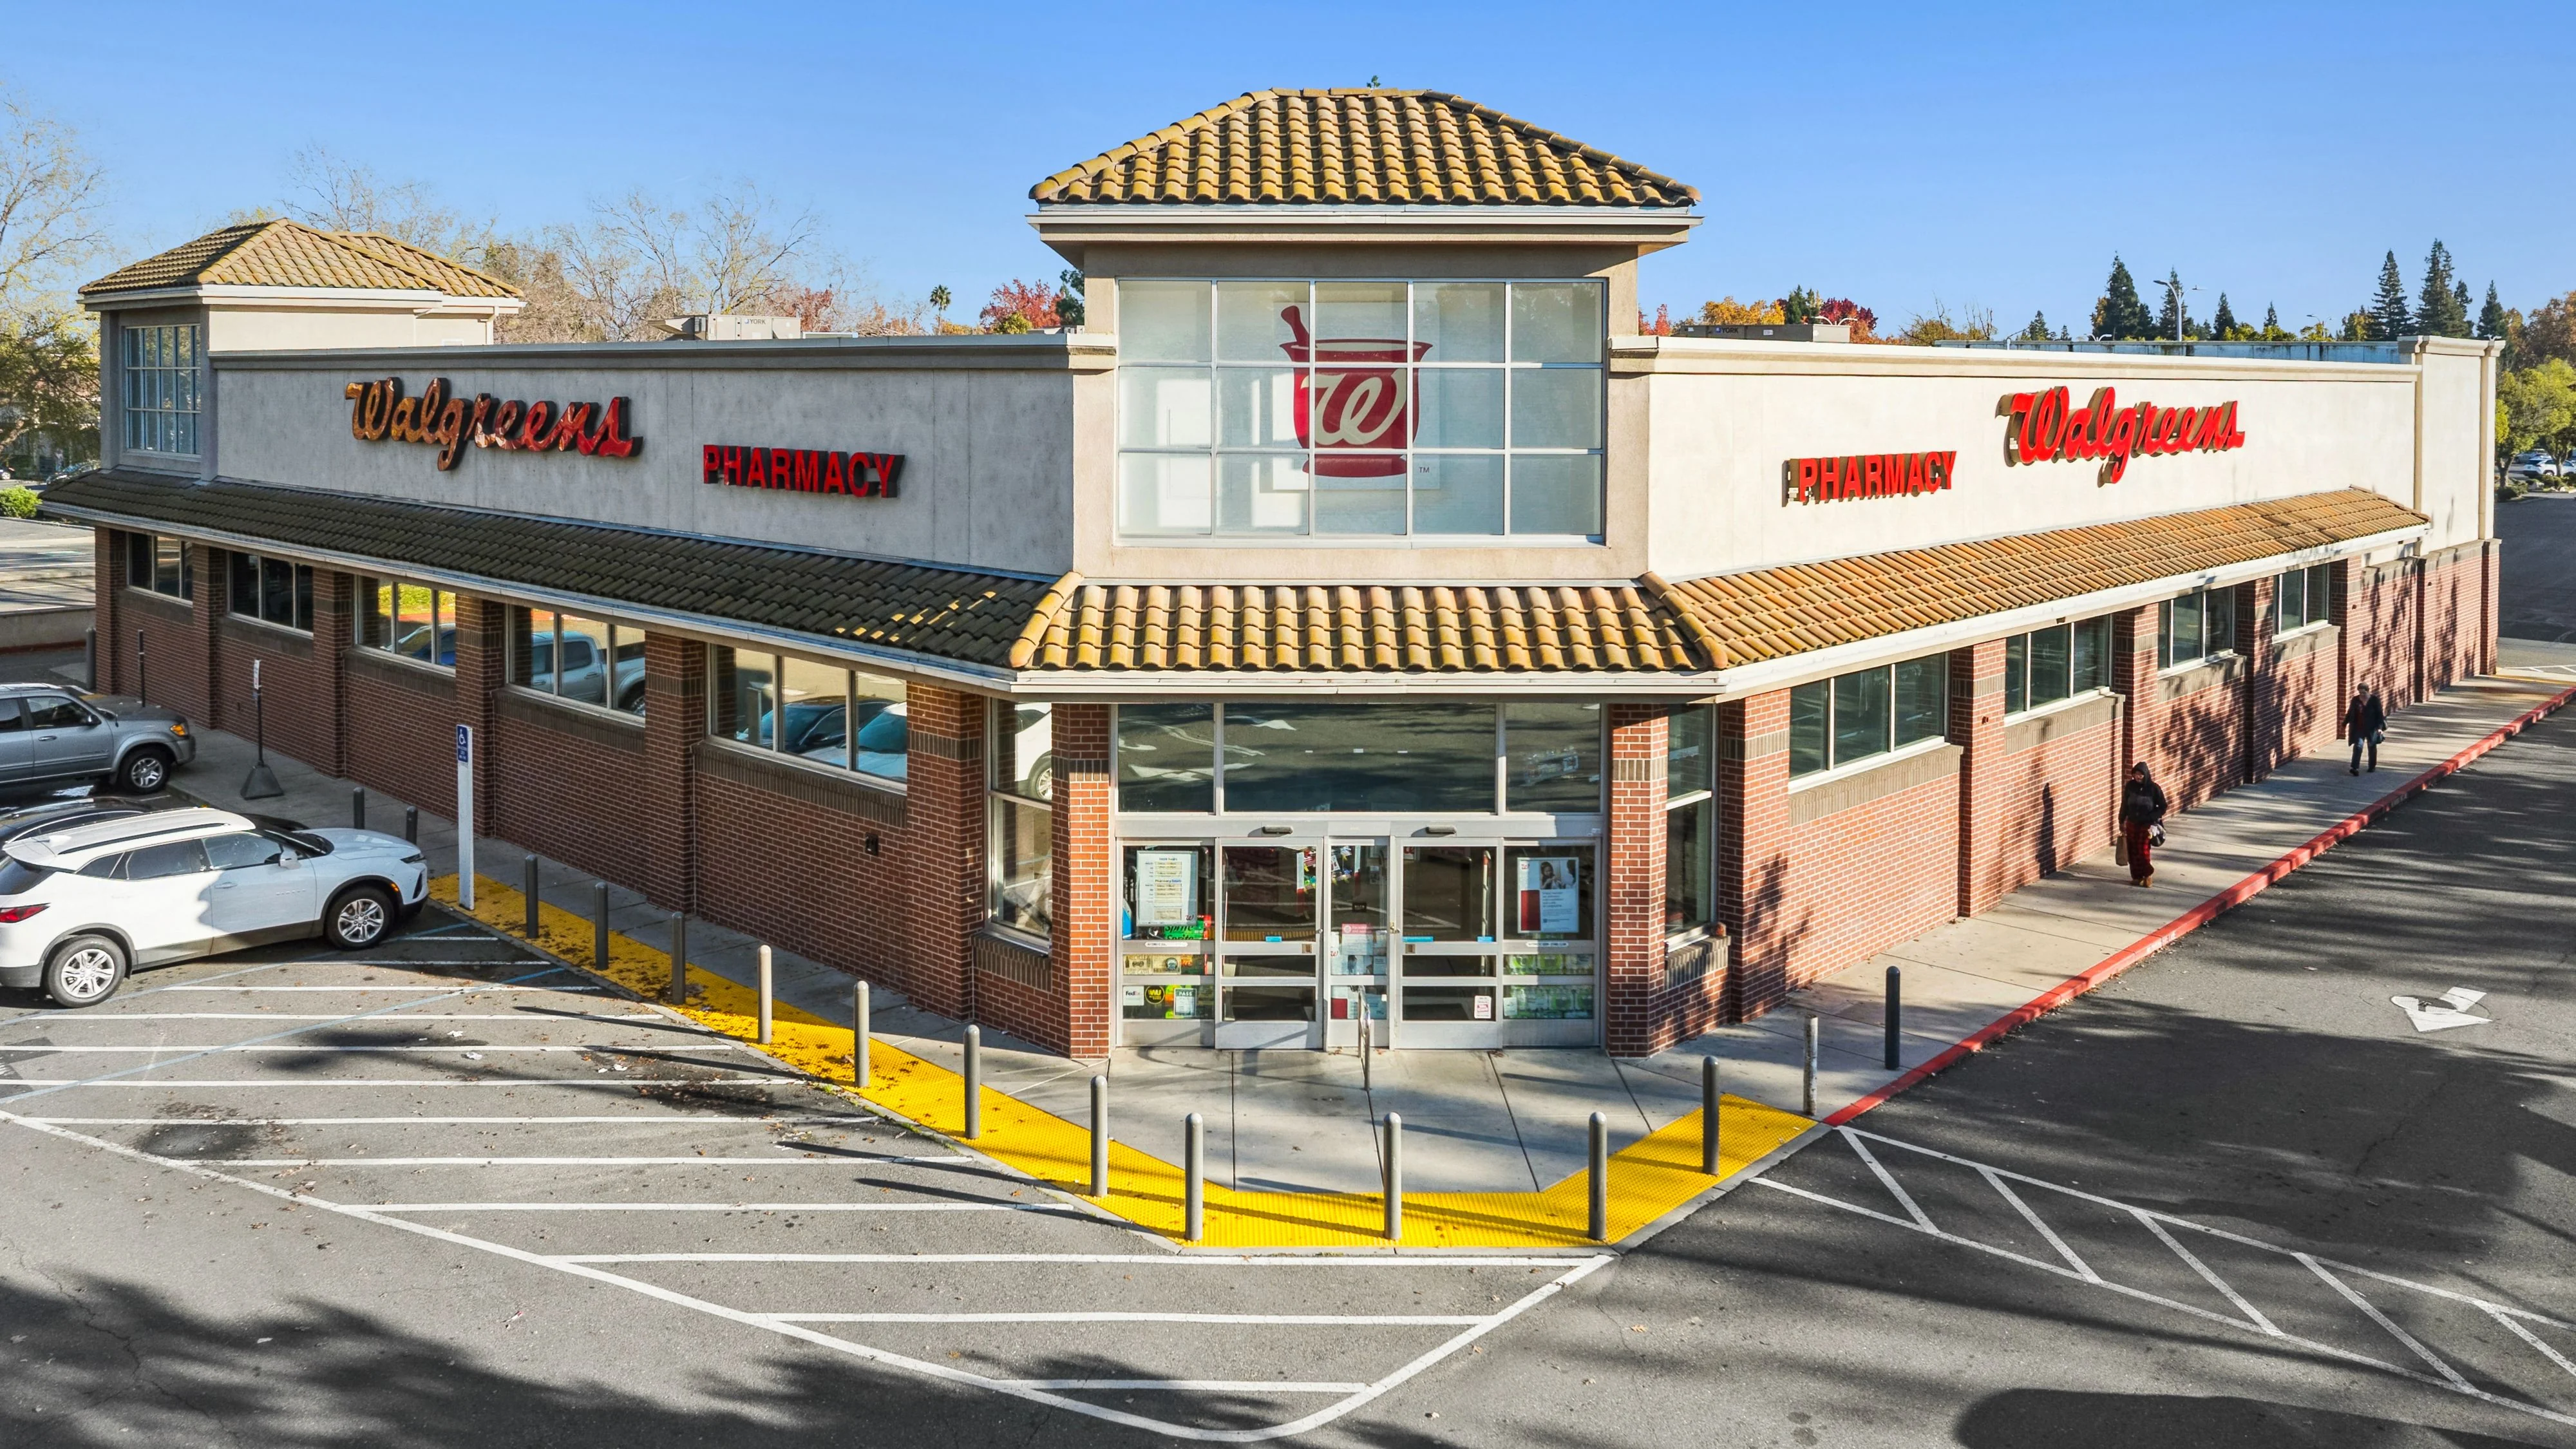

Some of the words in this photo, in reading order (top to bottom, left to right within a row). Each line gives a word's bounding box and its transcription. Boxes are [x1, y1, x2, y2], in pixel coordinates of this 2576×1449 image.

[346, 377, 643, 471] Walgreens
[2009, 386, 2246, 484] Walgreens
[703, 444, 904, 498] PHARMACY
[1799, 450, 1957, 502] PHARMACY
